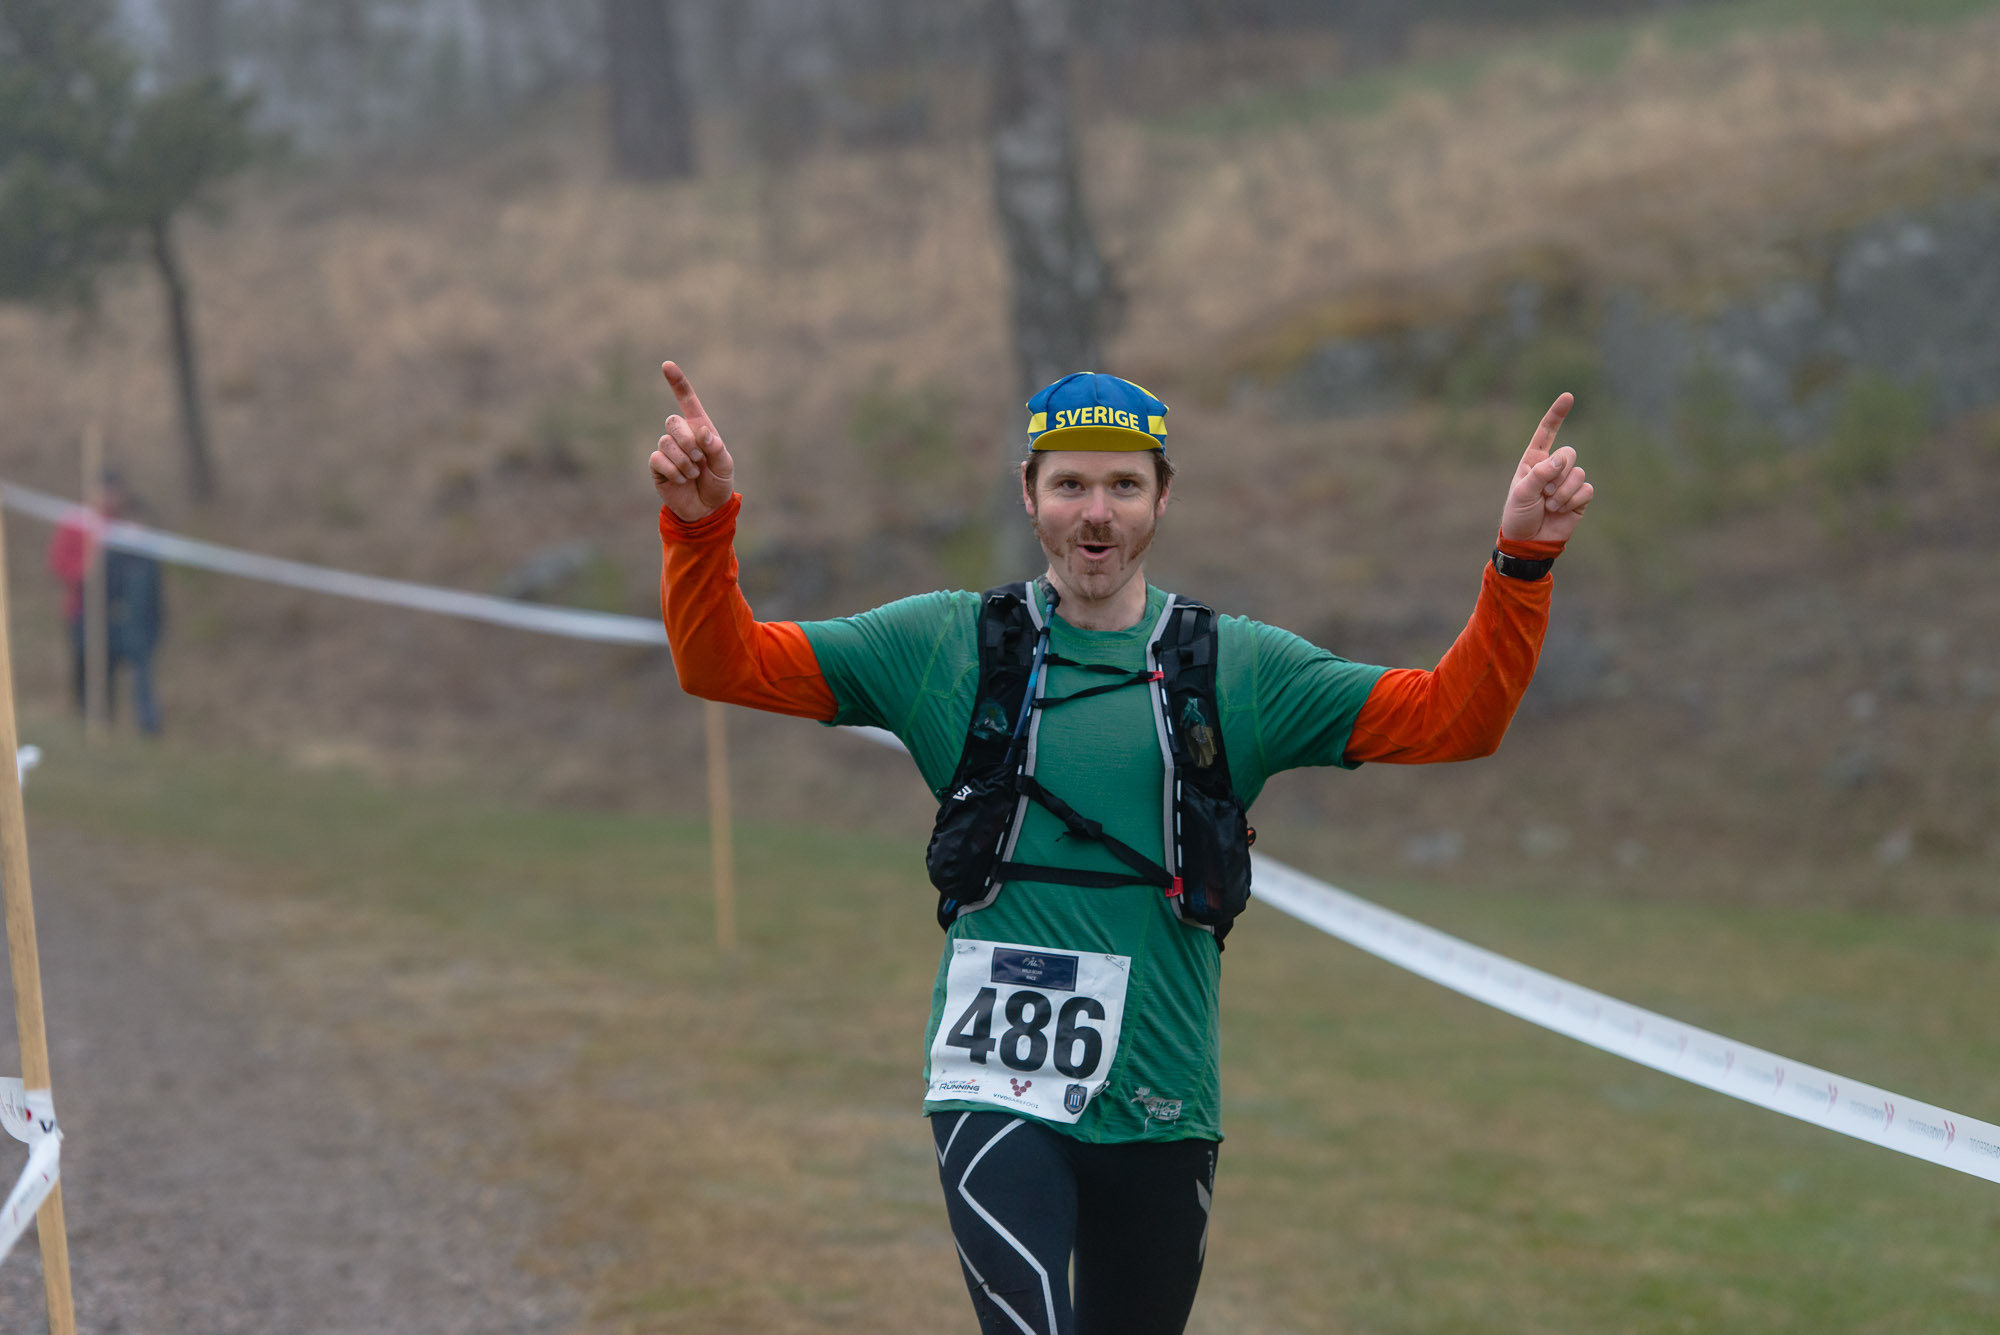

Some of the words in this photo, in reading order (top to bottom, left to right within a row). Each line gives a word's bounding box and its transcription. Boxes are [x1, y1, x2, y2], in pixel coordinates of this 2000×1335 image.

[1055, 406, 1140, 431] SVERIGE
[945, 986, 1106, 1079] 486
[939, 1082, 980, 1091] RUNNING
[993, 1093, 1039, 1109] VIVOBAREFOOT
